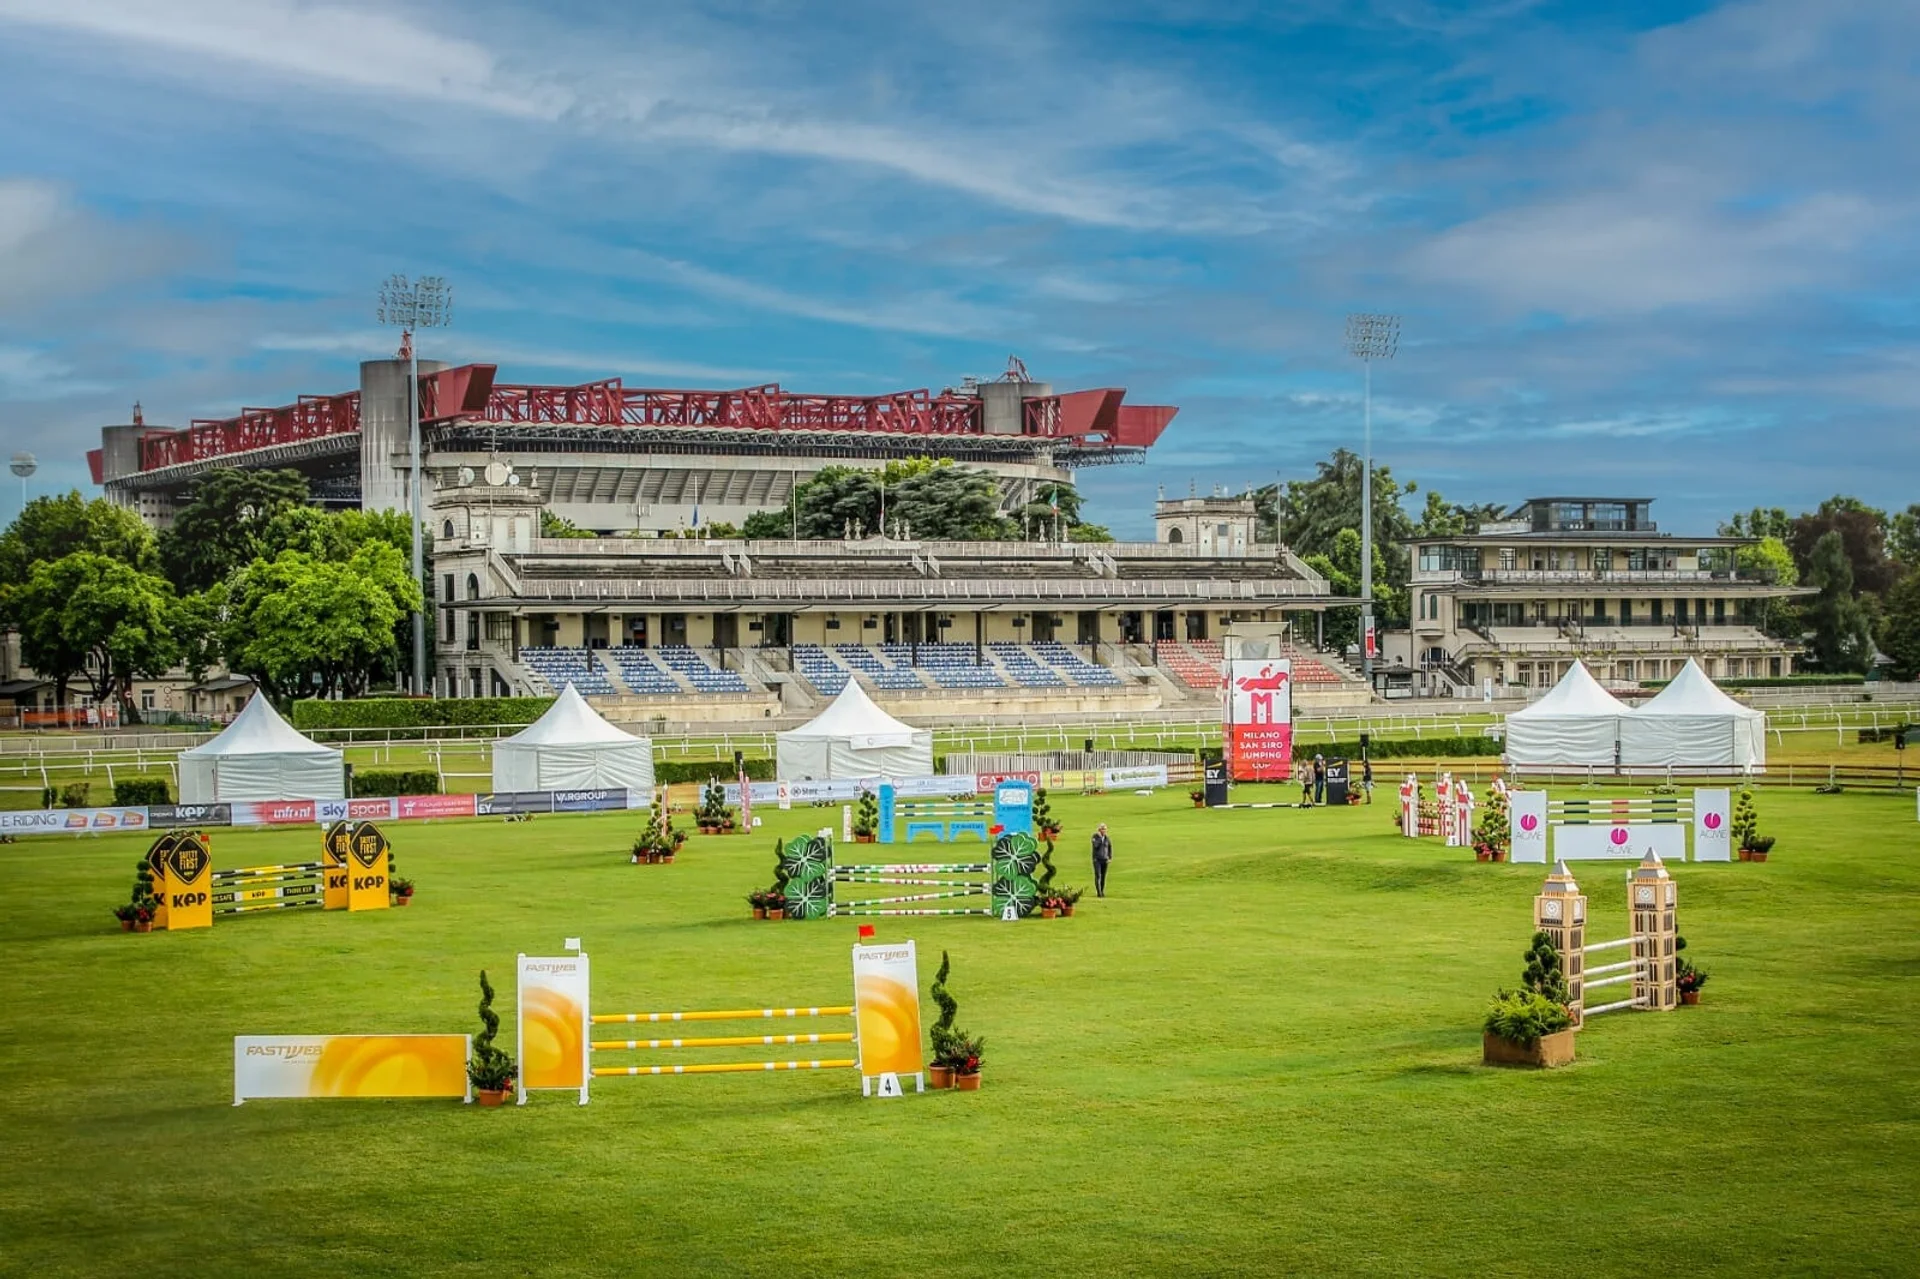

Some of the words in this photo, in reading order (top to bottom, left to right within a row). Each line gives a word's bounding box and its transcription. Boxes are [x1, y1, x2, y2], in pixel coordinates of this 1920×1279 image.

[1243, 731, 1280, 739] MILANO
[1262, 741, 1283, 749] SIRO
[1243, 751, 1282, 759] JUMPING
[1206, 769, 1220, 778] EY
[1327, 768, 1341, 777] EY
[322, 803, 346, 818] sky
[351, 803, 389, 816] sport
[478, 803, 492, 814] EY
[1515, 831, 1542, 840] ACME
[1700, 830, 1727, 838] ACME
[360, 842, 376, 854] FIRST
[1606, 844, 1632, 854] ACME
[179, 858, 198, 870] FIRST
[246, 1045, 323, 1059] FASTWEB
[884, 1077, 892, 1094] 4
